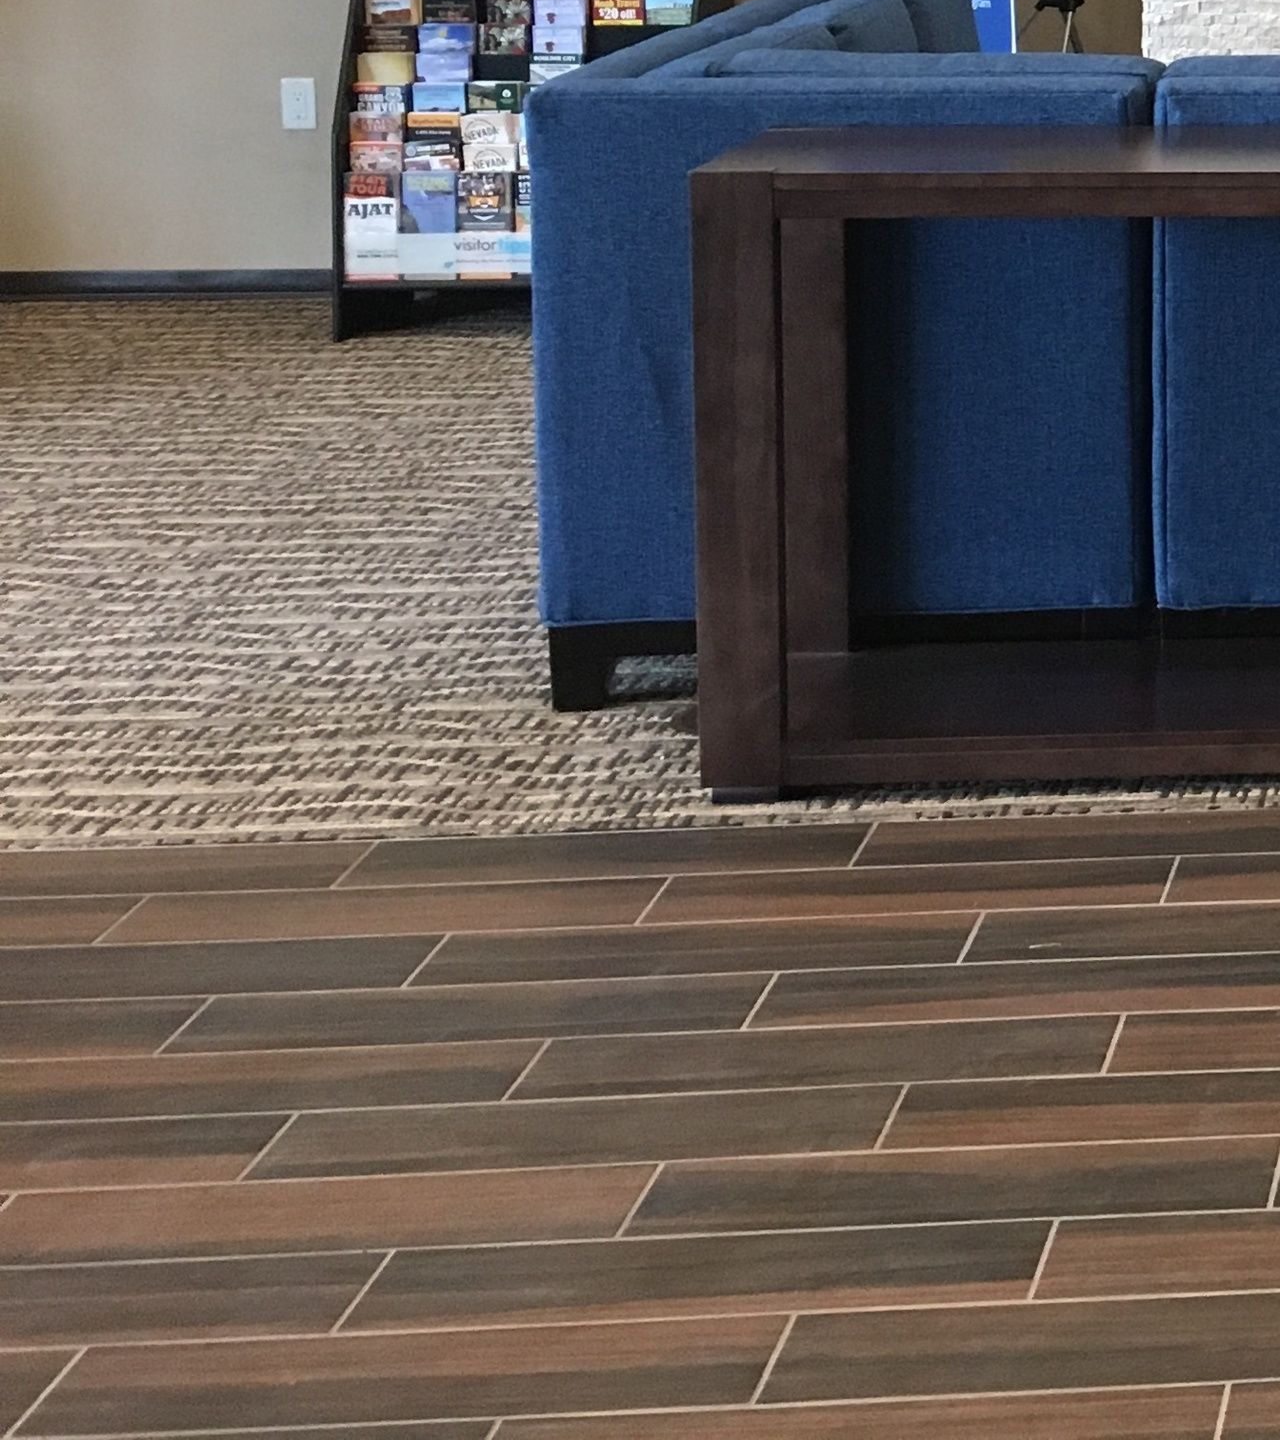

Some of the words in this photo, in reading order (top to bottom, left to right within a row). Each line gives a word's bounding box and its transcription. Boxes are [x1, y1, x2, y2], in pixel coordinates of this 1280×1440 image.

[465, 126, 499, 140] NEVADA
[472, 158, 508, 170] NEVADA
[454, 238, 497, 252] visitor
